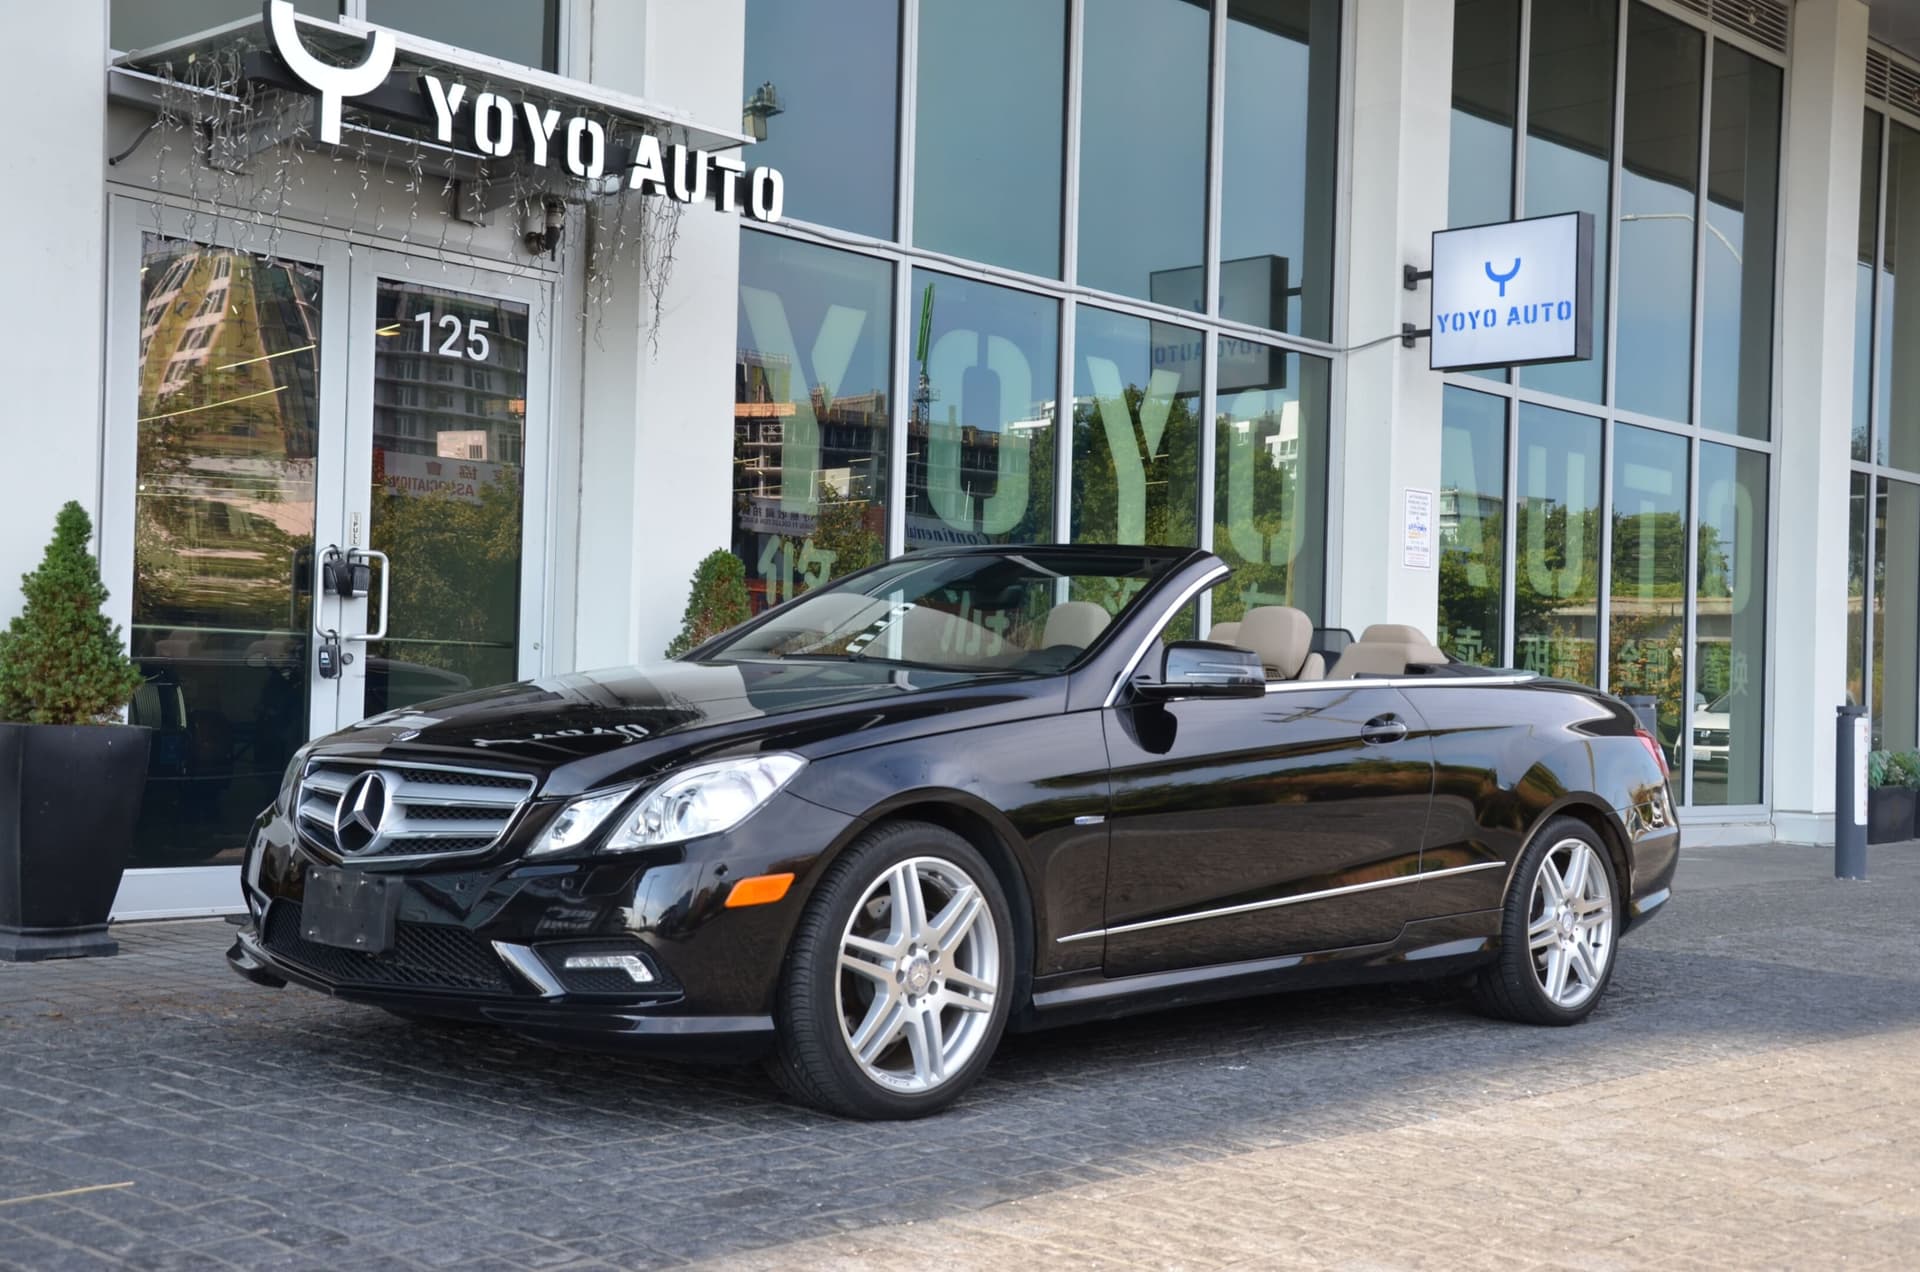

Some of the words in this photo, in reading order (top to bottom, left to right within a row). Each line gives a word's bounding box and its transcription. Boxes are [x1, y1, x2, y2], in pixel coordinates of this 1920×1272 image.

[419, 75, 605, 179] YOYO
[629, 133, 785, 223] AUTO
[415, 311, 490, 362] 125
[1437, 308, 1497, 333] YOYO
[1507, 300, 1572, 326] AUTO
